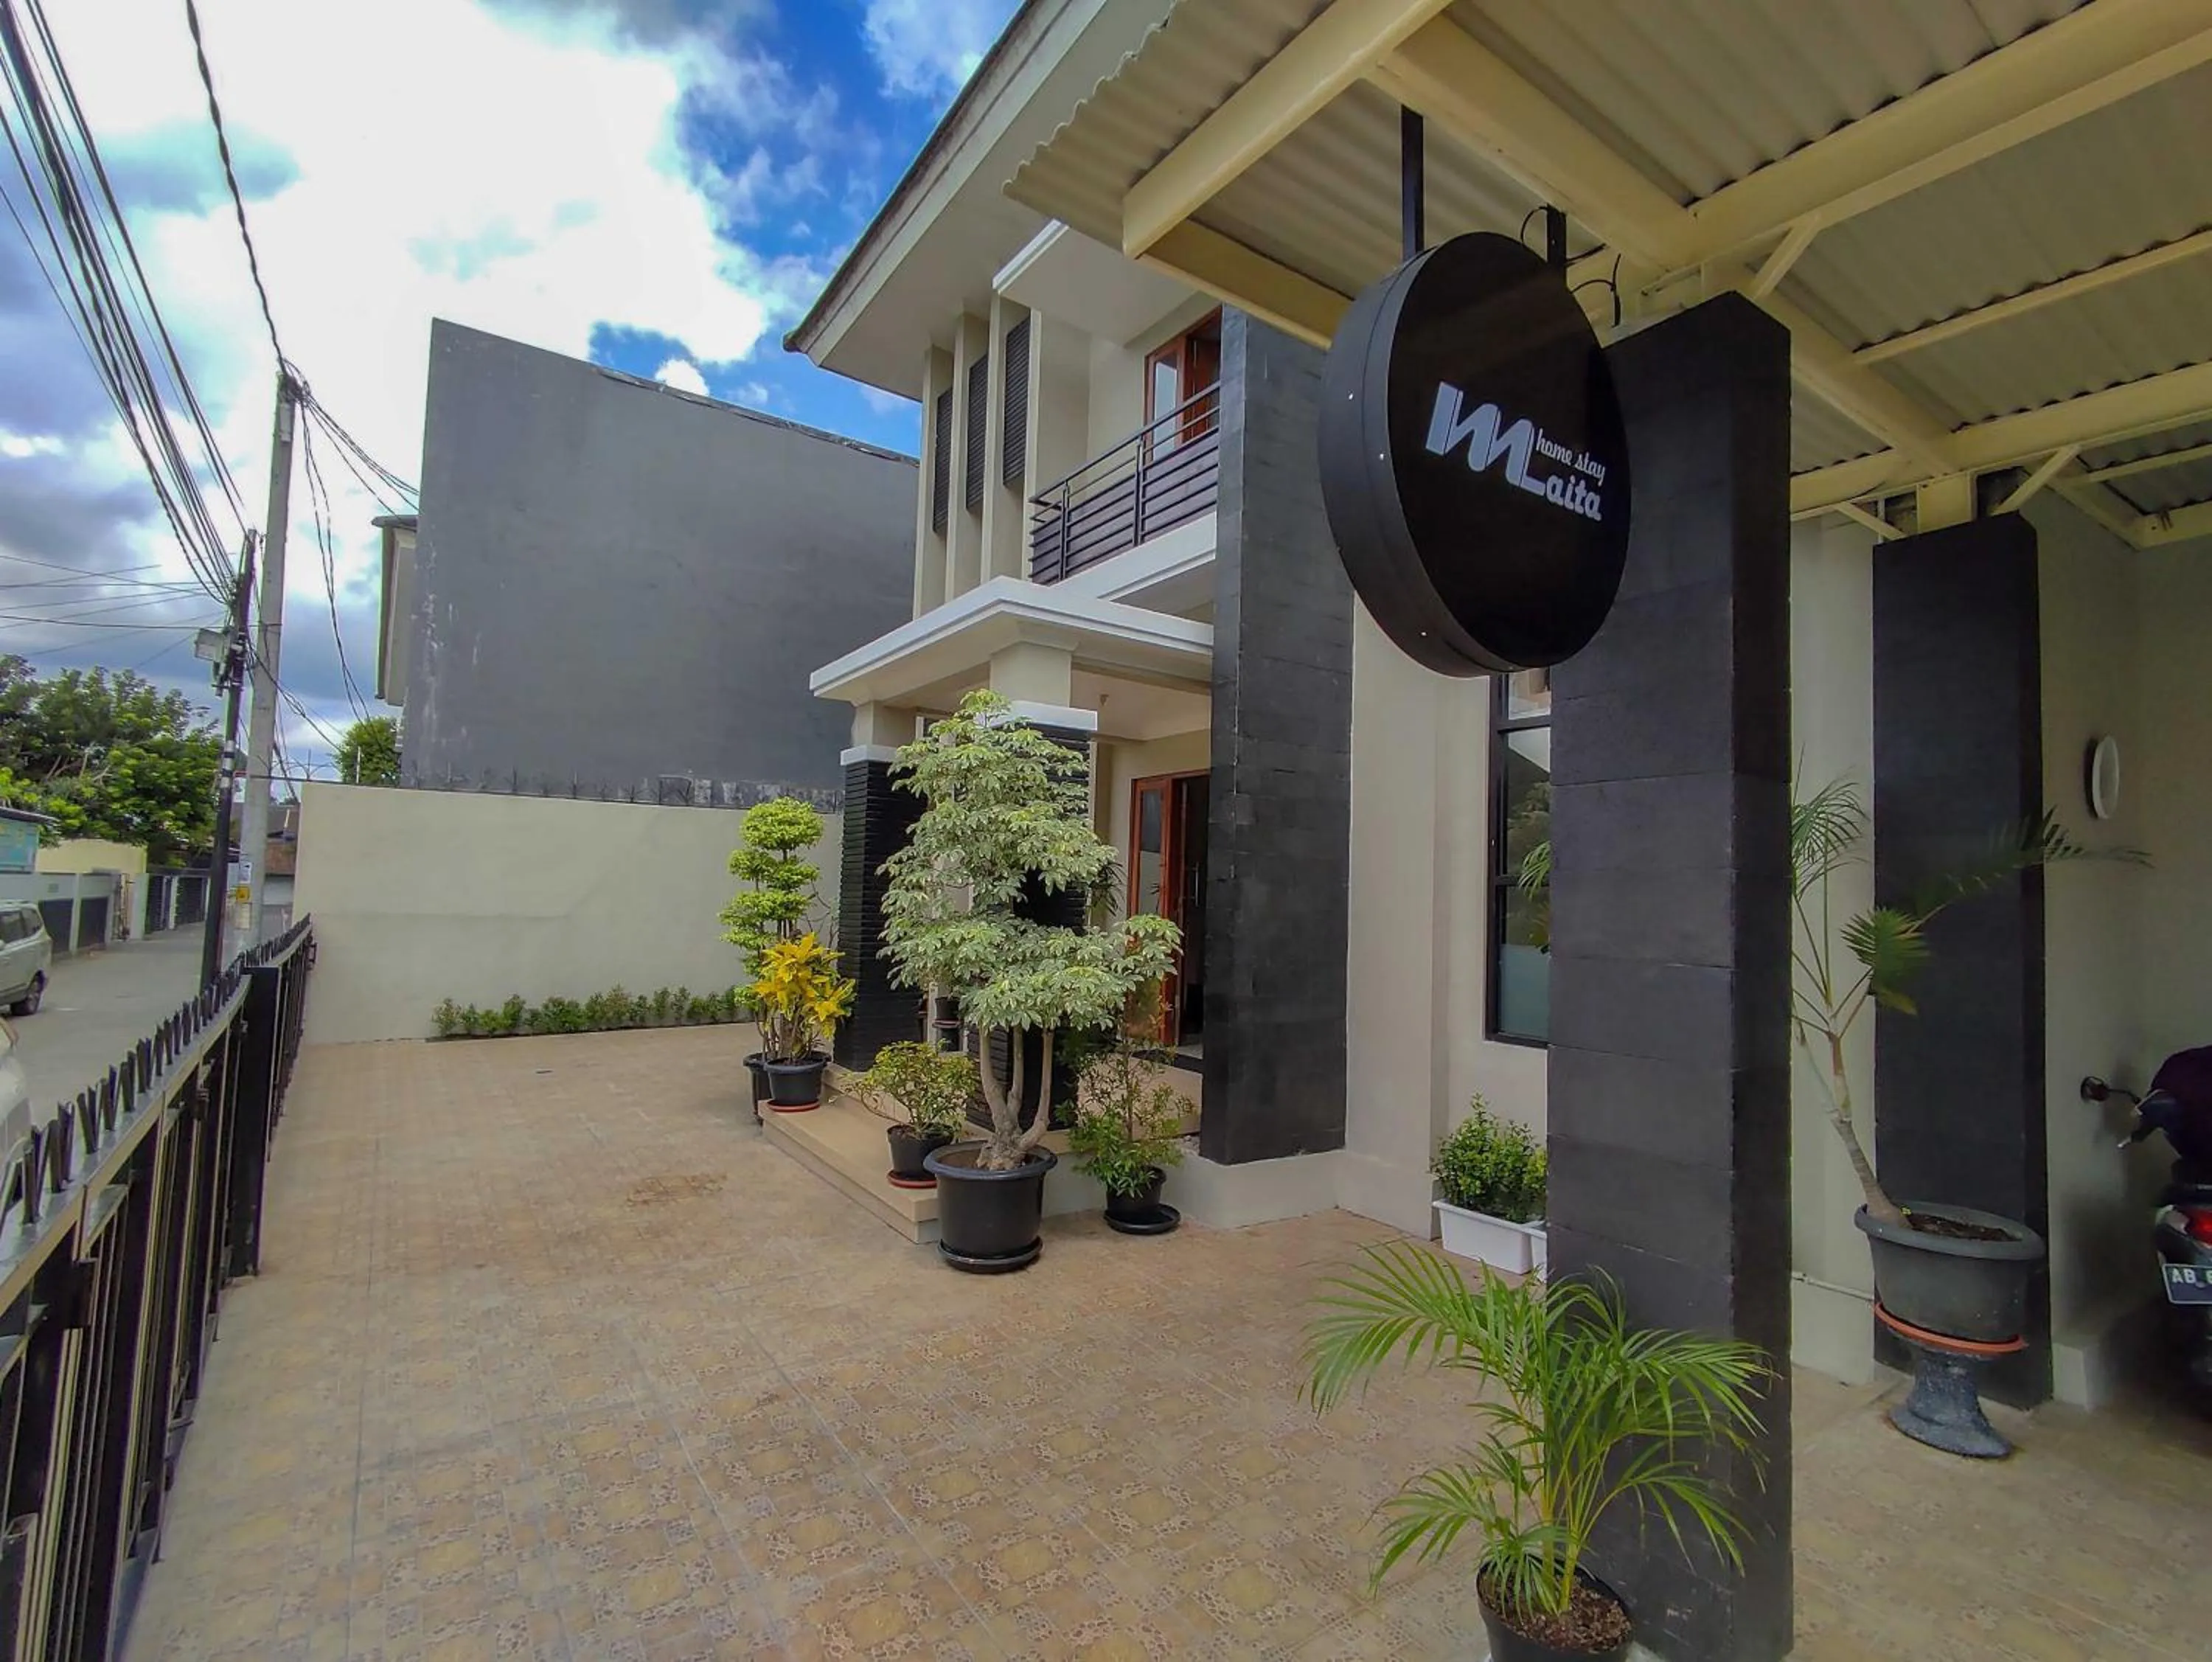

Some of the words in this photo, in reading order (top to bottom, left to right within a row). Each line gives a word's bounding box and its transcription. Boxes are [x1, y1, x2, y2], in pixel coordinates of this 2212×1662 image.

[1536, 428, 1573, 462] home
[1575, 452, 1606, 487] stay
[2171, 1268, 2197, 1284] AB
